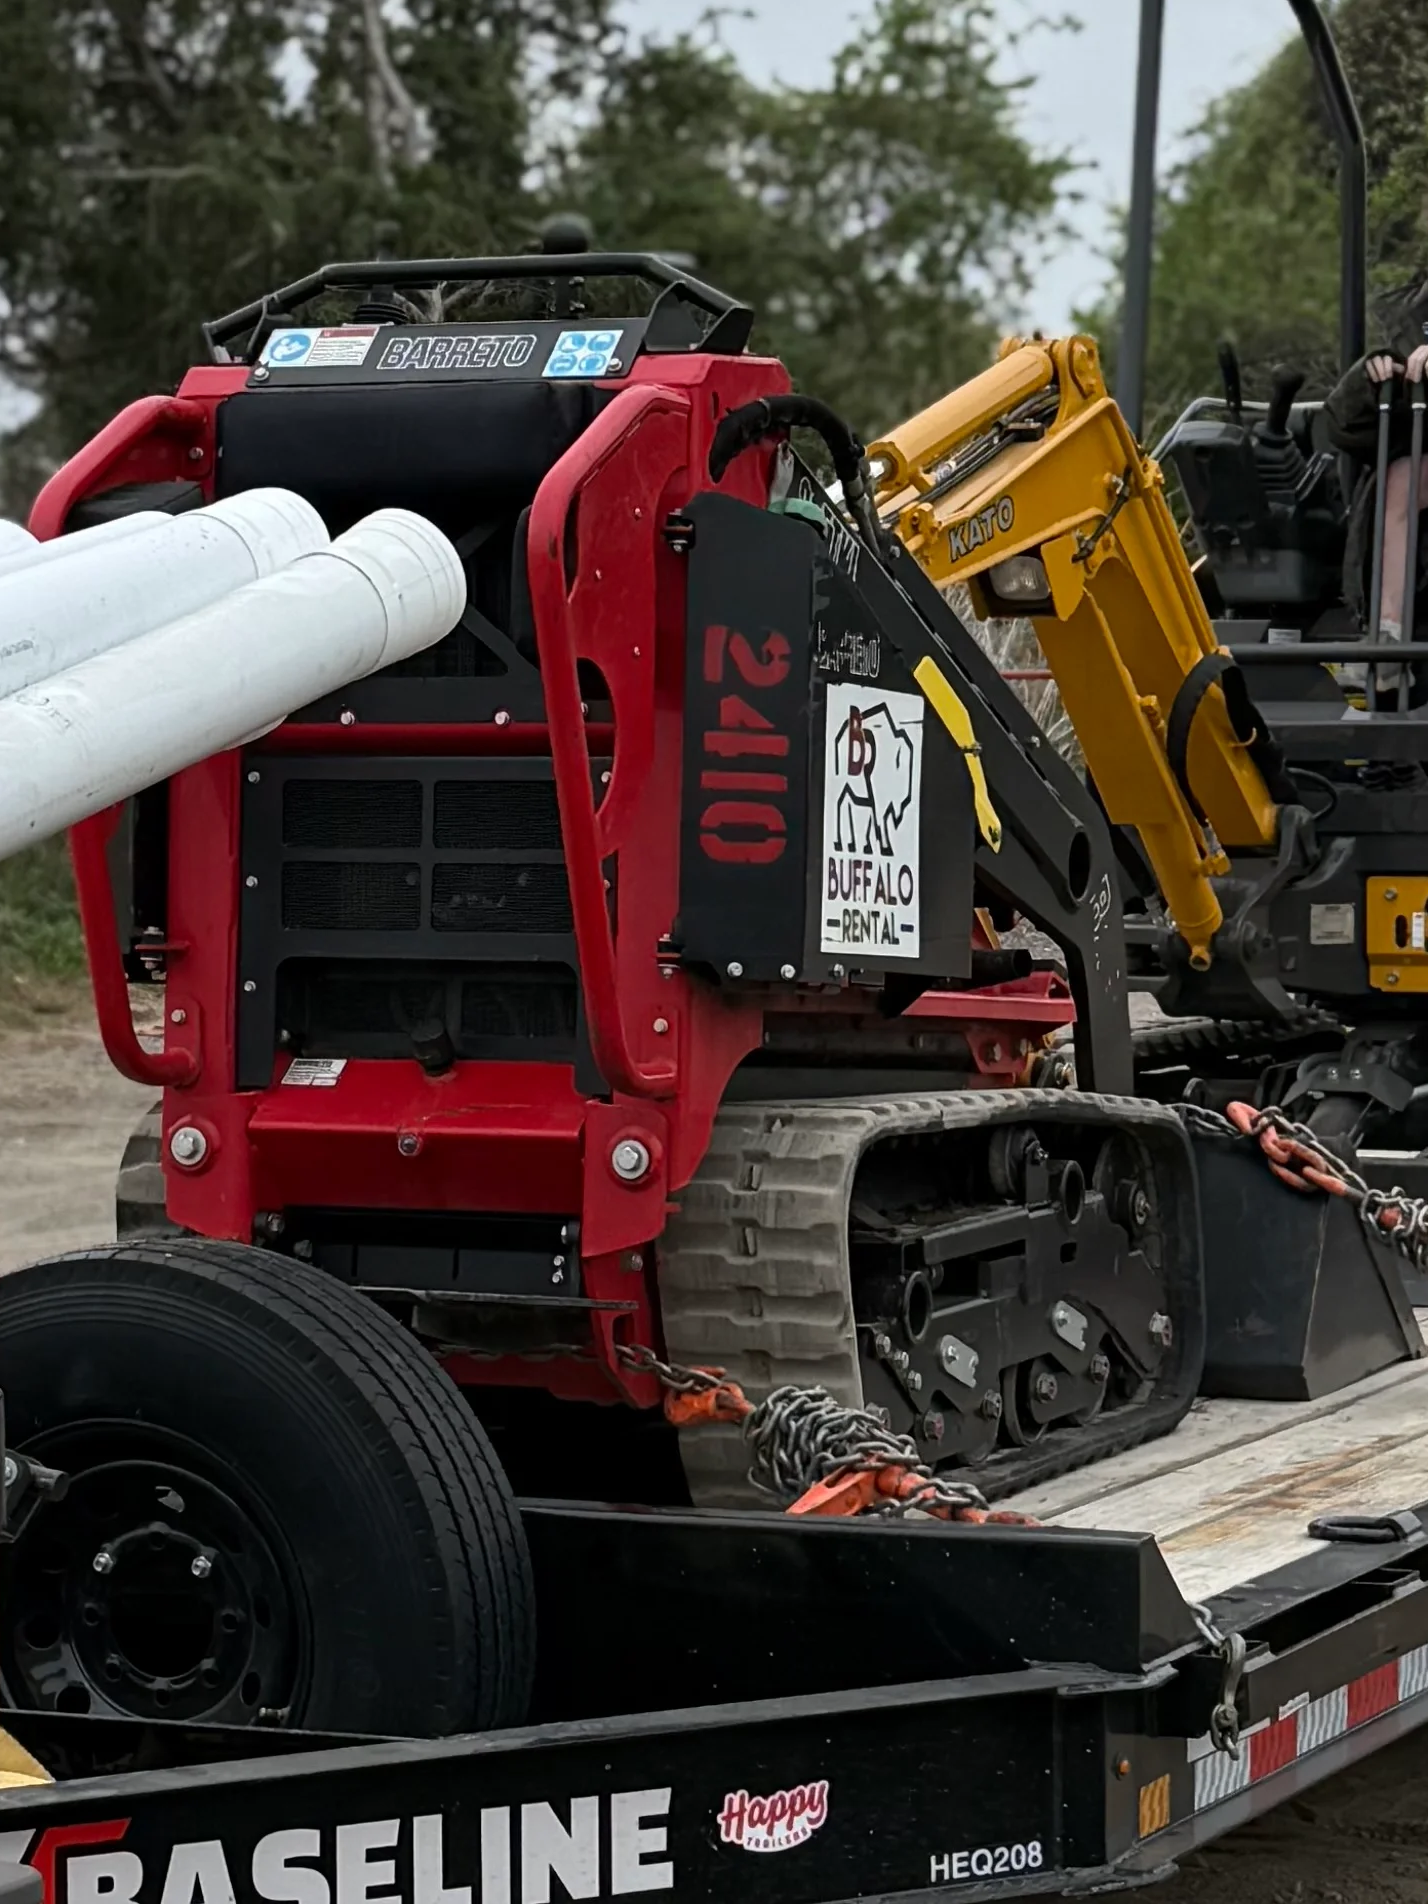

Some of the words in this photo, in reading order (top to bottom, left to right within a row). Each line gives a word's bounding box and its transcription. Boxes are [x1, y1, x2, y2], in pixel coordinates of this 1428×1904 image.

[377, 334, 537, 370] BARRETO
[949, 496, 1014, 563] KATO
[699, 625, 792, 864] 2410
[827, 856, 914, 906] BUFFALO
[841, 909, 900, 945] RENTAL
[720, 1782, 827, 1841] Happy
[930, 1840, 1043, 1882] HEQ208
